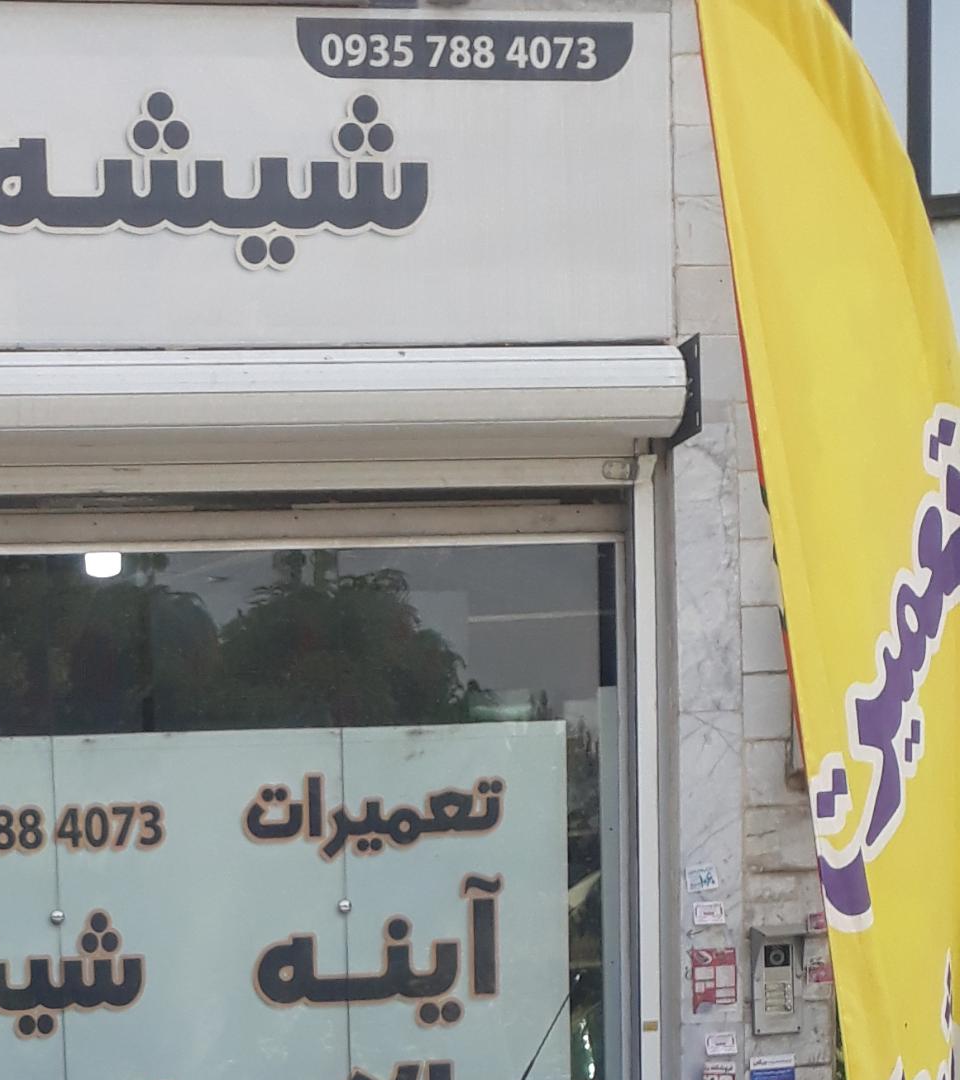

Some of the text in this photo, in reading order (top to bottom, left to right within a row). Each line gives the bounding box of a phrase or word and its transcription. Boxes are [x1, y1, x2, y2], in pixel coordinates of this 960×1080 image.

[320, 33, 598, 70] 0935 788 4073
[56, 804, 163, 850] 4073
[245, 775, 503, 859] تعمیرات
[256, 874, 502, 1025] آینه
